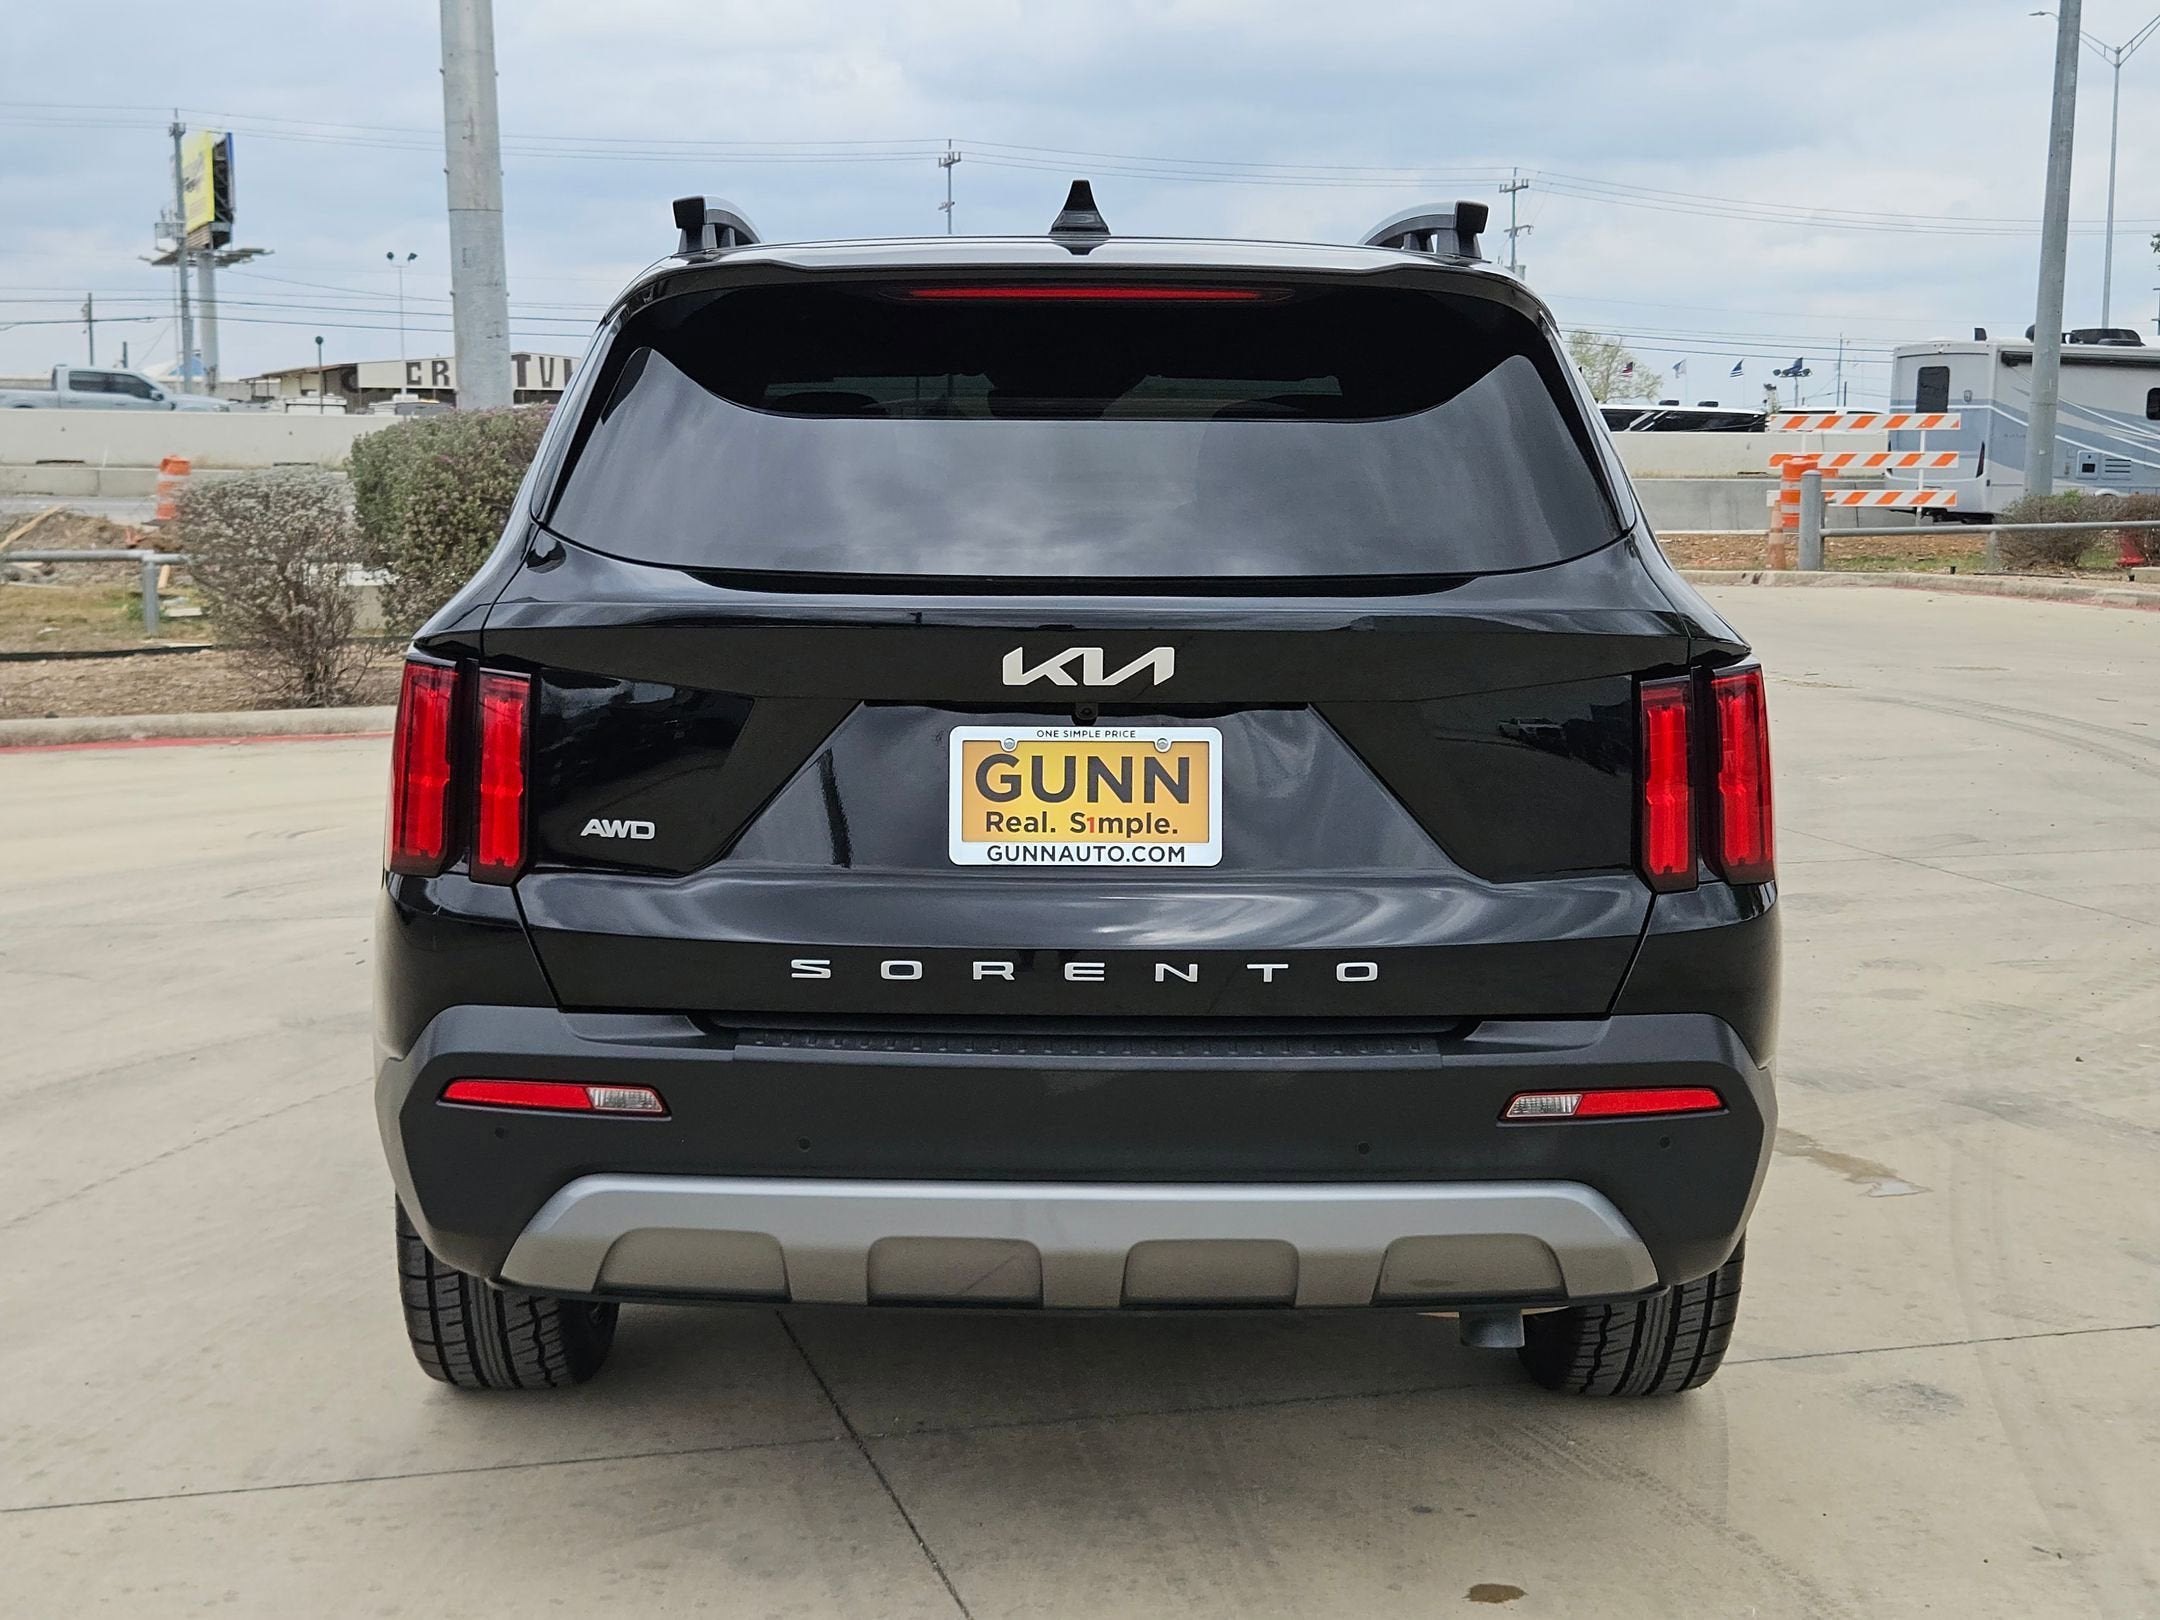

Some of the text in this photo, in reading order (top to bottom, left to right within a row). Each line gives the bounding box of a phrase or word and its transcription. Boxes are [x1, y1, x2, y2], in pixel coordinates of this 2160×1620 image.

[1003, 647, 1175, 686] KIA
[1036, 730, 1136, 739] ONE SIMPLE PRICE
[975, 753, 1190, 804] GUNN
[580, 818, 655, 840] AWD
[985, 811, 1056, 833] Real.
[987, 845, 1185, 863] GUNNAUTO.COM
[790, 959, 1378, 982] SORENTO
